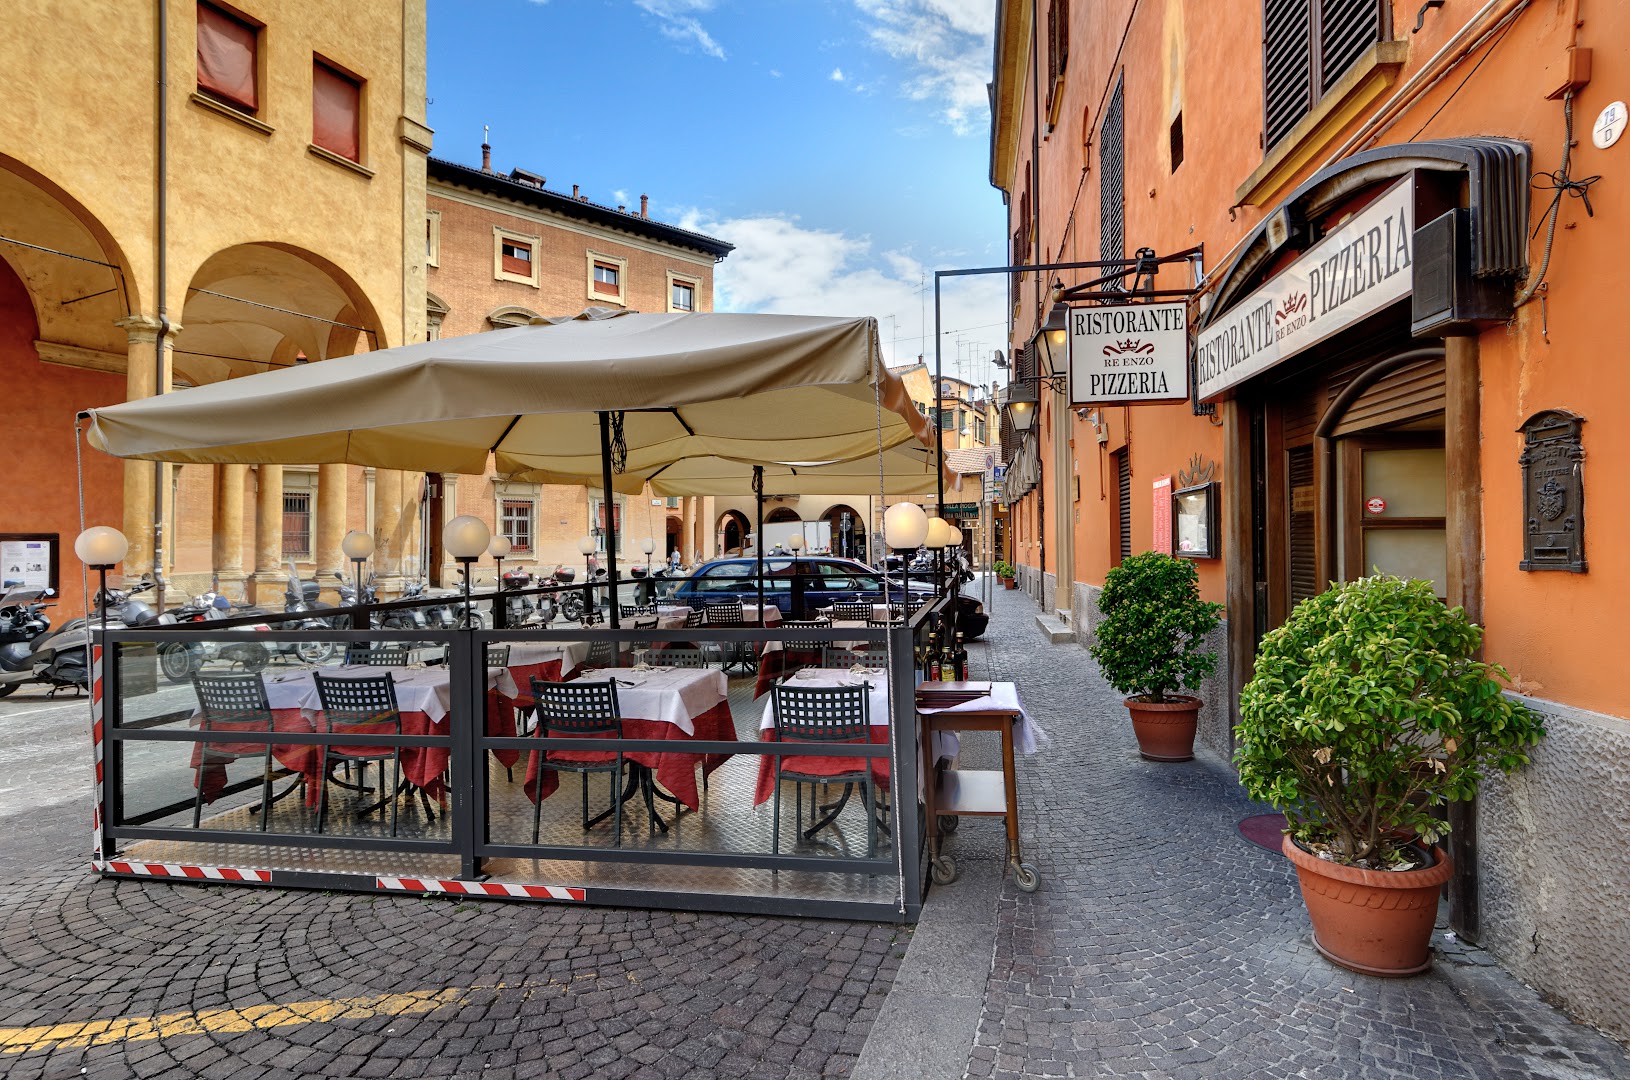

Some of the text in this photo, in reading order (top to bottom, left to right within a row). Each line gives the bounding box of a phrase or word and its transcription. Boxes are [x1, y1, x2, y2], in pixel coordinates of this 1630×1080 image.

[1604, 107, 1616, 126] 79
[1604, 128, 1613, 142] D
[1199, 206, 1412, 387] RISTORANTE RE ENZO PIZZERIA
[1074, 308, 1184, 336] RISTORANTE
[1104, 356, 1154, 368] RE ENZO
[1090, 371, 1169, 396] PIZZERIA
